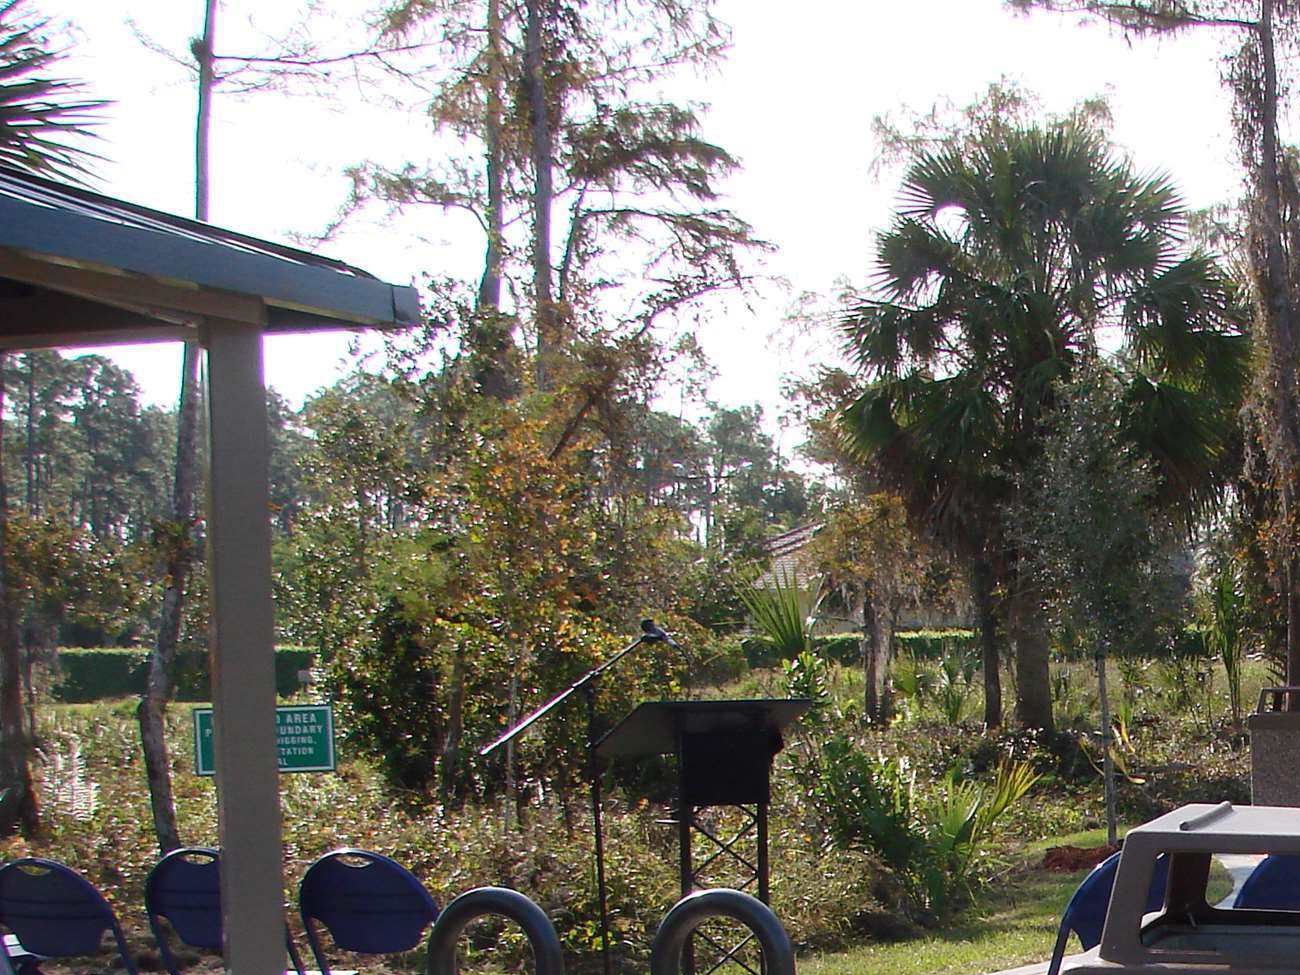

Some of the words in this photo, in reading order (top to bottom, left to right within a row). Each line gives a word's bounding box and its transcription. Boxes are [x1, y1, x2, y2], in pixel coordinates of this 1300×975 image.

[286, 713, 317, 724] AREA
[279, 725, 322, 735] UNDARY
[279, 747, 314, 756] TATION
